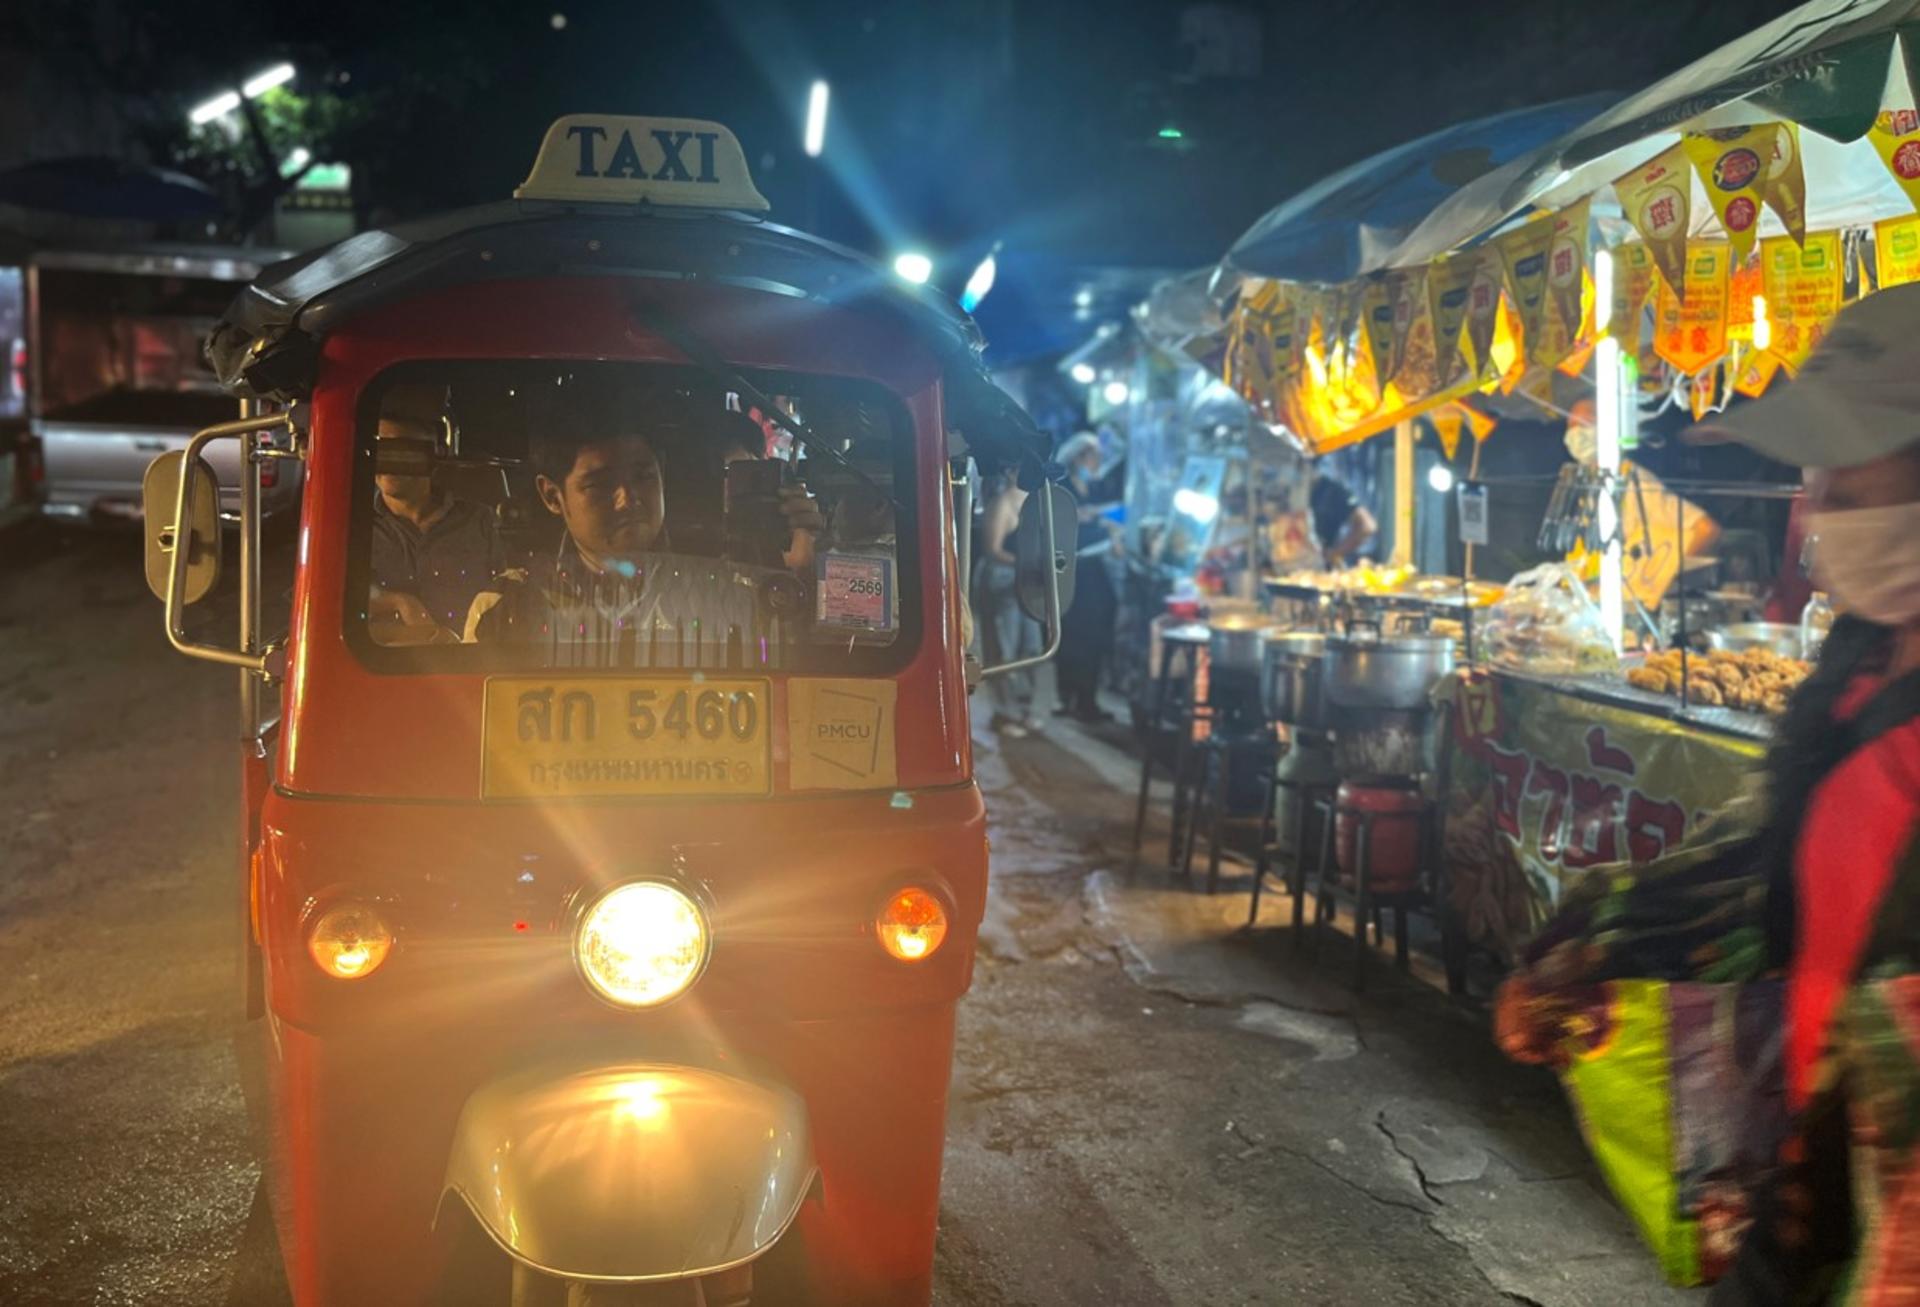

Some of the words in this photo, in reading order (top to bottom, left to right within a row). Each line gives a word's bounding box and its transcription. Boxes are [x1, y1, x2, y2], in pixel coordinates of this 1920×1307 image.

[566, 126, 720, 183] TAXI
[849, 579, 882, 597] 2569
[517, 686, 596, 742] สก
[627, 689, 757, 743] 5460
[817, 723, 871, 739] PMCU
